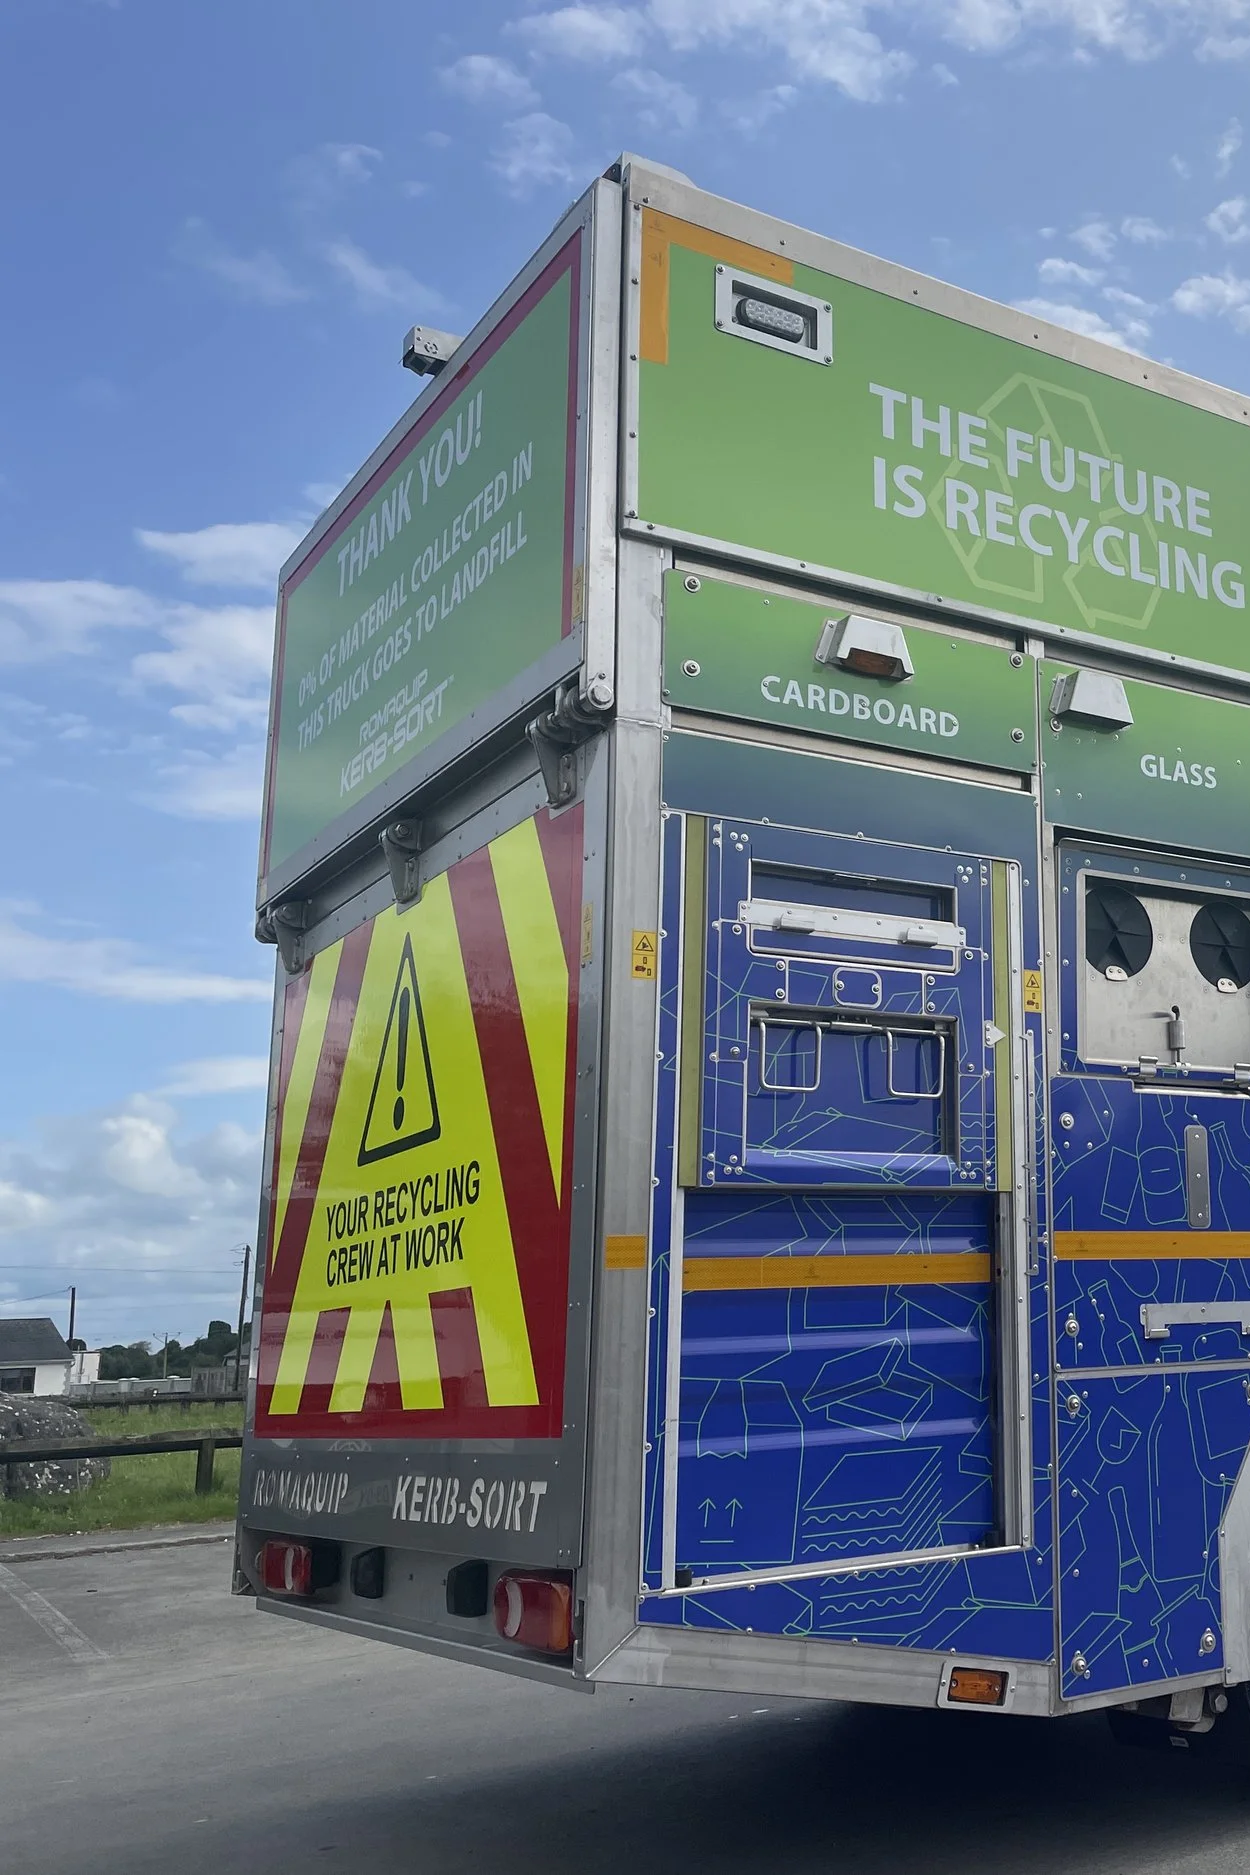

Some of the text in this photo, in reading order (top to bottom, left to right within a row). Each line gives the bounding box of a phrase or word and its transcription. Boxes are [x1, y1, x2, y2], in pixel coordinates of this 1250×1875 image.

[337, 390, 484, 597] THANK YOU!
[869, 382, 1213, 538] THE FUTURE
[319, 643, 337, 685] OF
[338, 572, 407, 668] MATERIAL
[411, 468, 508, 593] COLLECTED
[512, 442, 534, 496] IN
[872, 455, 1245, 609] IS RECYCLING
[298, 511, 528, 752] THIS TRUCK GOES TO LANDFILL
[340, 681, 447, 798] KERB-SORT
[359, 668, 429, 746] ROMAQUIP
[761, 674, 960, 738] CARDBOARD
[1140, 753, 1217, 790] GLASS
[326, 1160, 480, 1242] YOUR RECYCLING
[326, 1216, 466, 1288] CREW AT WORK
[392, 1475, 548, 1532] KERB-SORT
